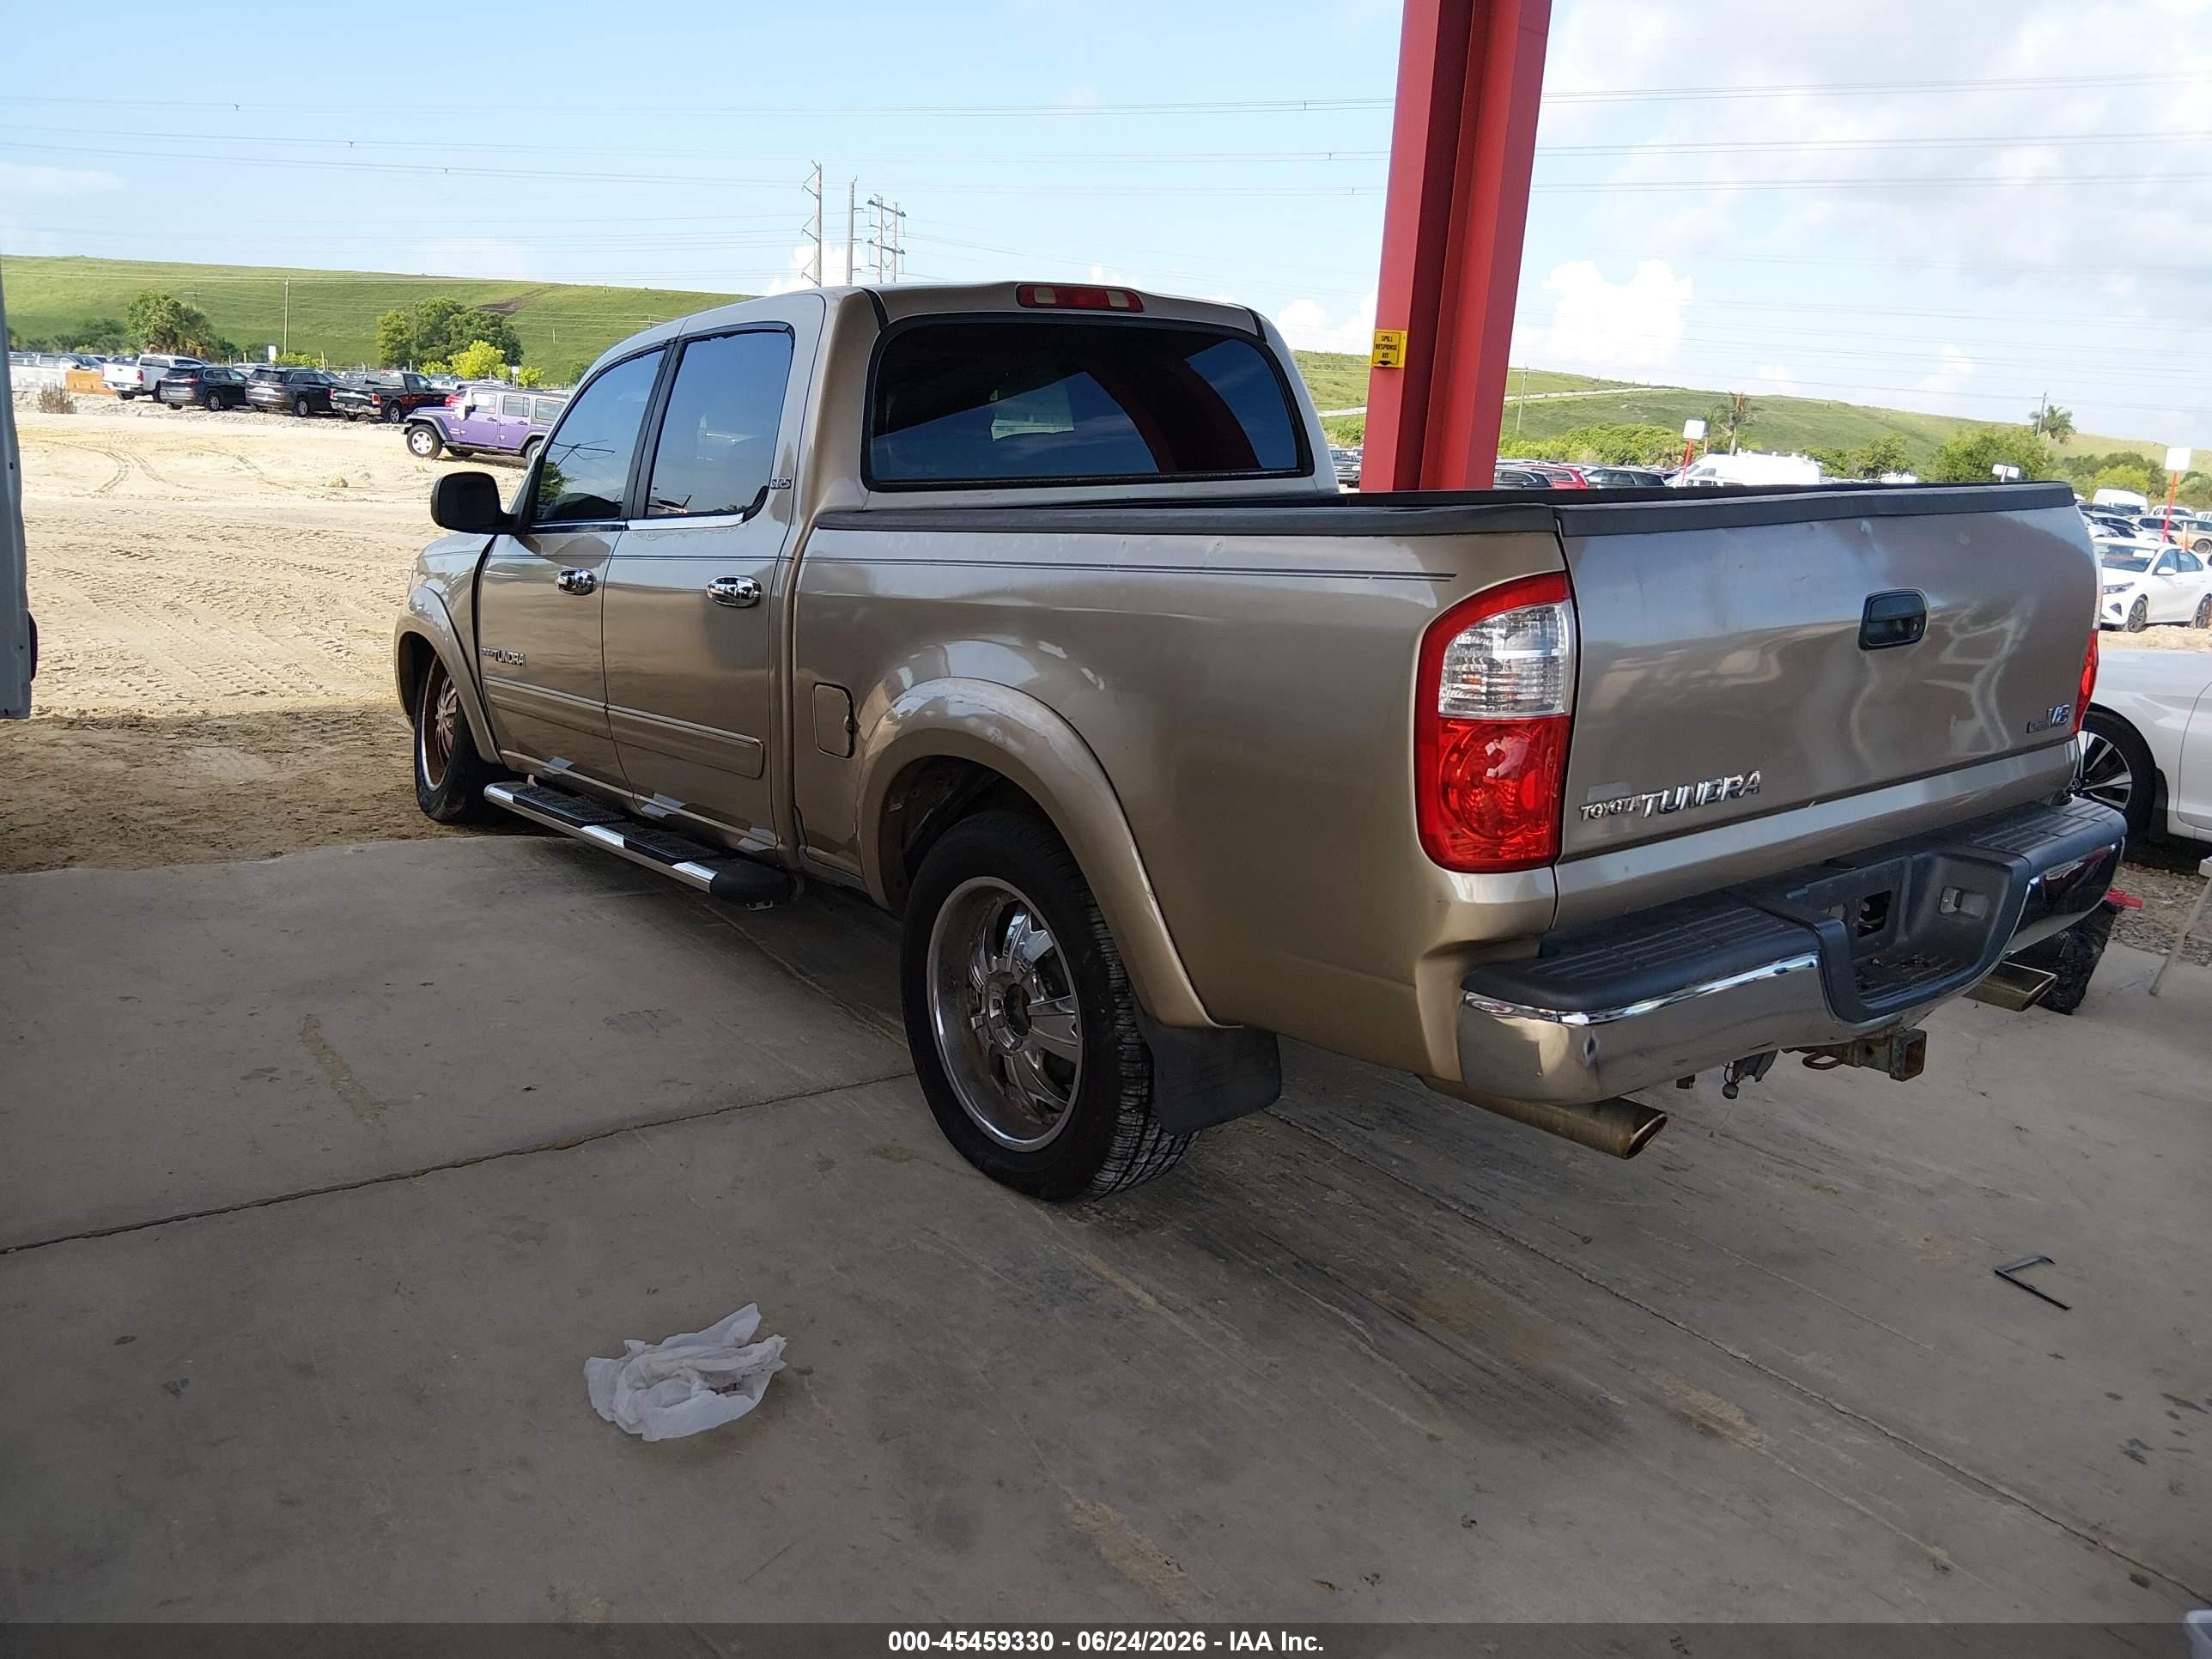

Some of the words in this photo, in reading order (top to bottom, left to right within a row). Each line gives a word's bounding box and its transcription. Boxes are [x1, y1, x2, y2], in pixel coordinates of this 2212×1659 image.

[494, 650, 527, 666] TUNDRA
[2046, 703, 2070, 728] V8
[1580, 794, 1642, 821] TOYOTA
[1640, 770, 1760, 817] TUNDRA
